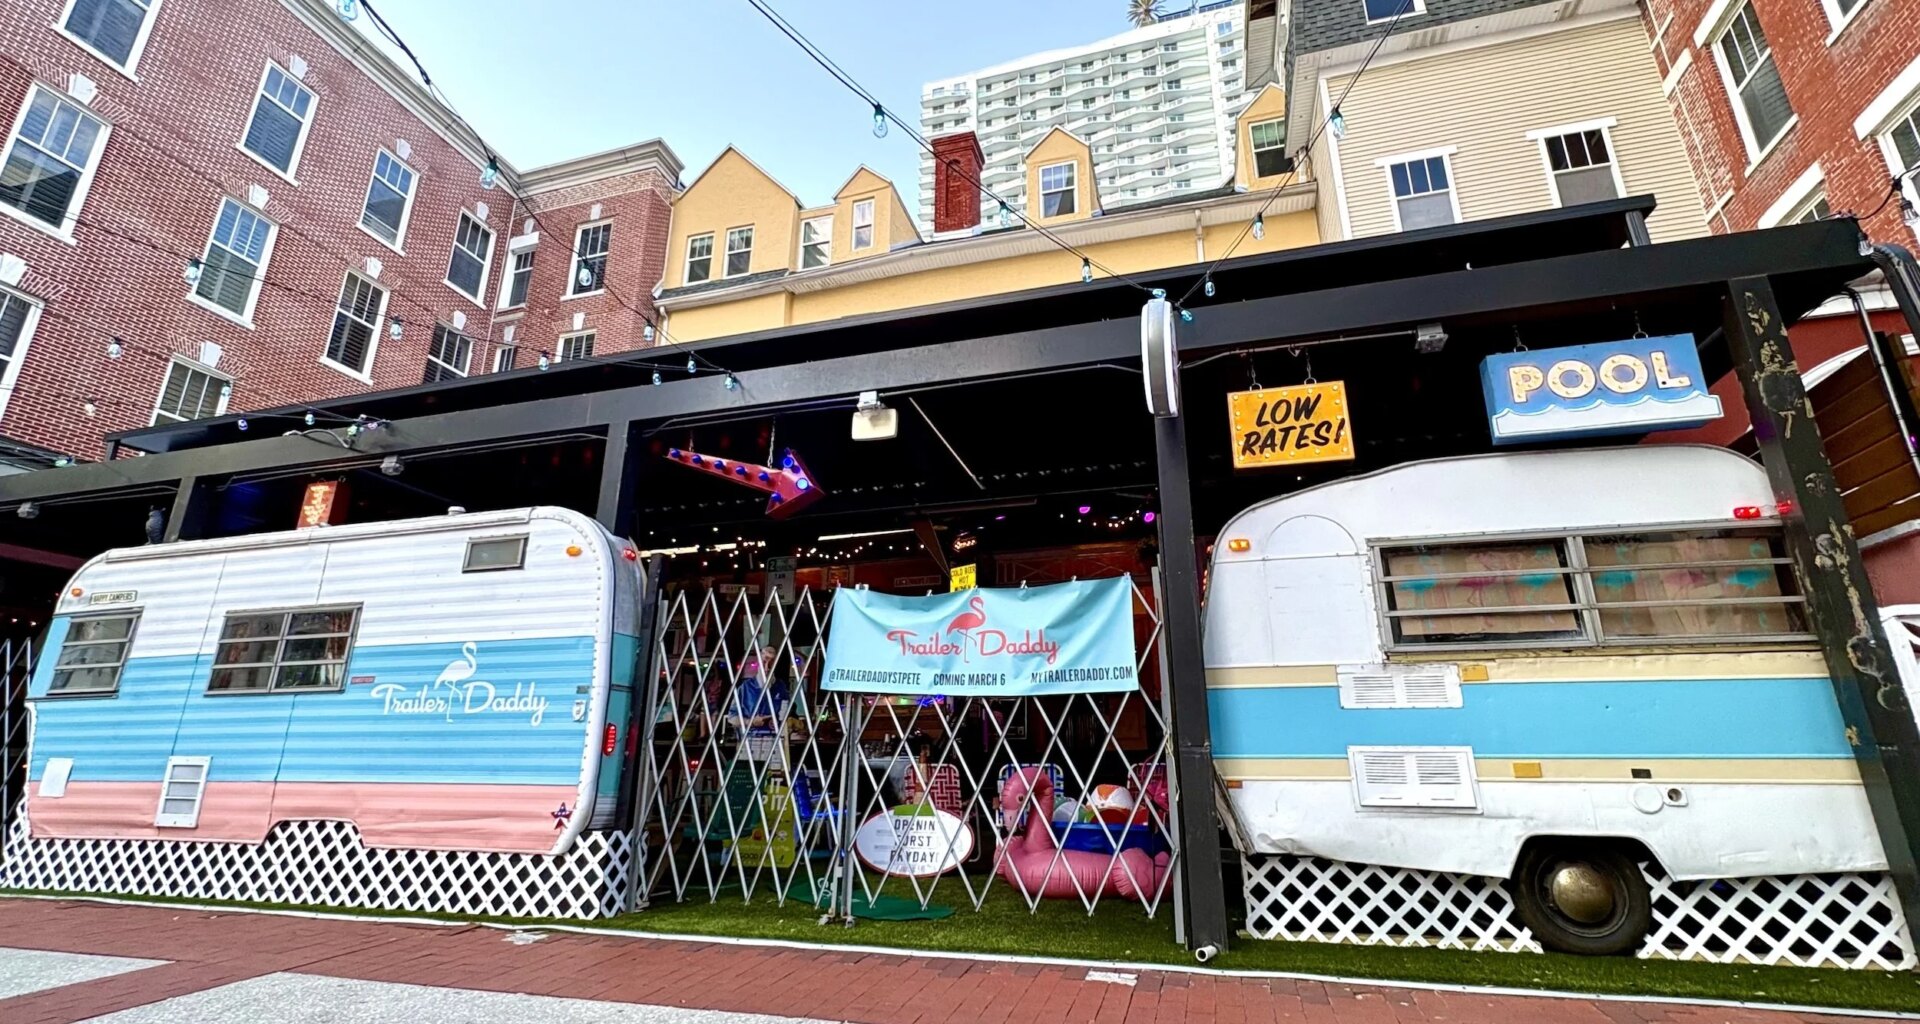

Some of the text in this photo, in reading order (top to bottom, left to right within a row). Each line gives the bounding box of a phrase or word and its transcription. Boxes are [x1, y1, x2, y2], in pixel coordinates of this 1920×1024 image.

[1508, 350, 1692, 404] POOL
[1255, 393, 1322, 428] LOW
[1241, 418, 1346, 456] RATES!
[109, 592, 133, 601] CAMPERS
[886, 629, 1061, 665] Trailer Daddy
[829, 665, 1133, 686] @TRAILERDADDYSTPETE COMING MARCH 6 MYTRAILERDADDY.COM
[370, 681, 551, 727] Trailer Daddy
